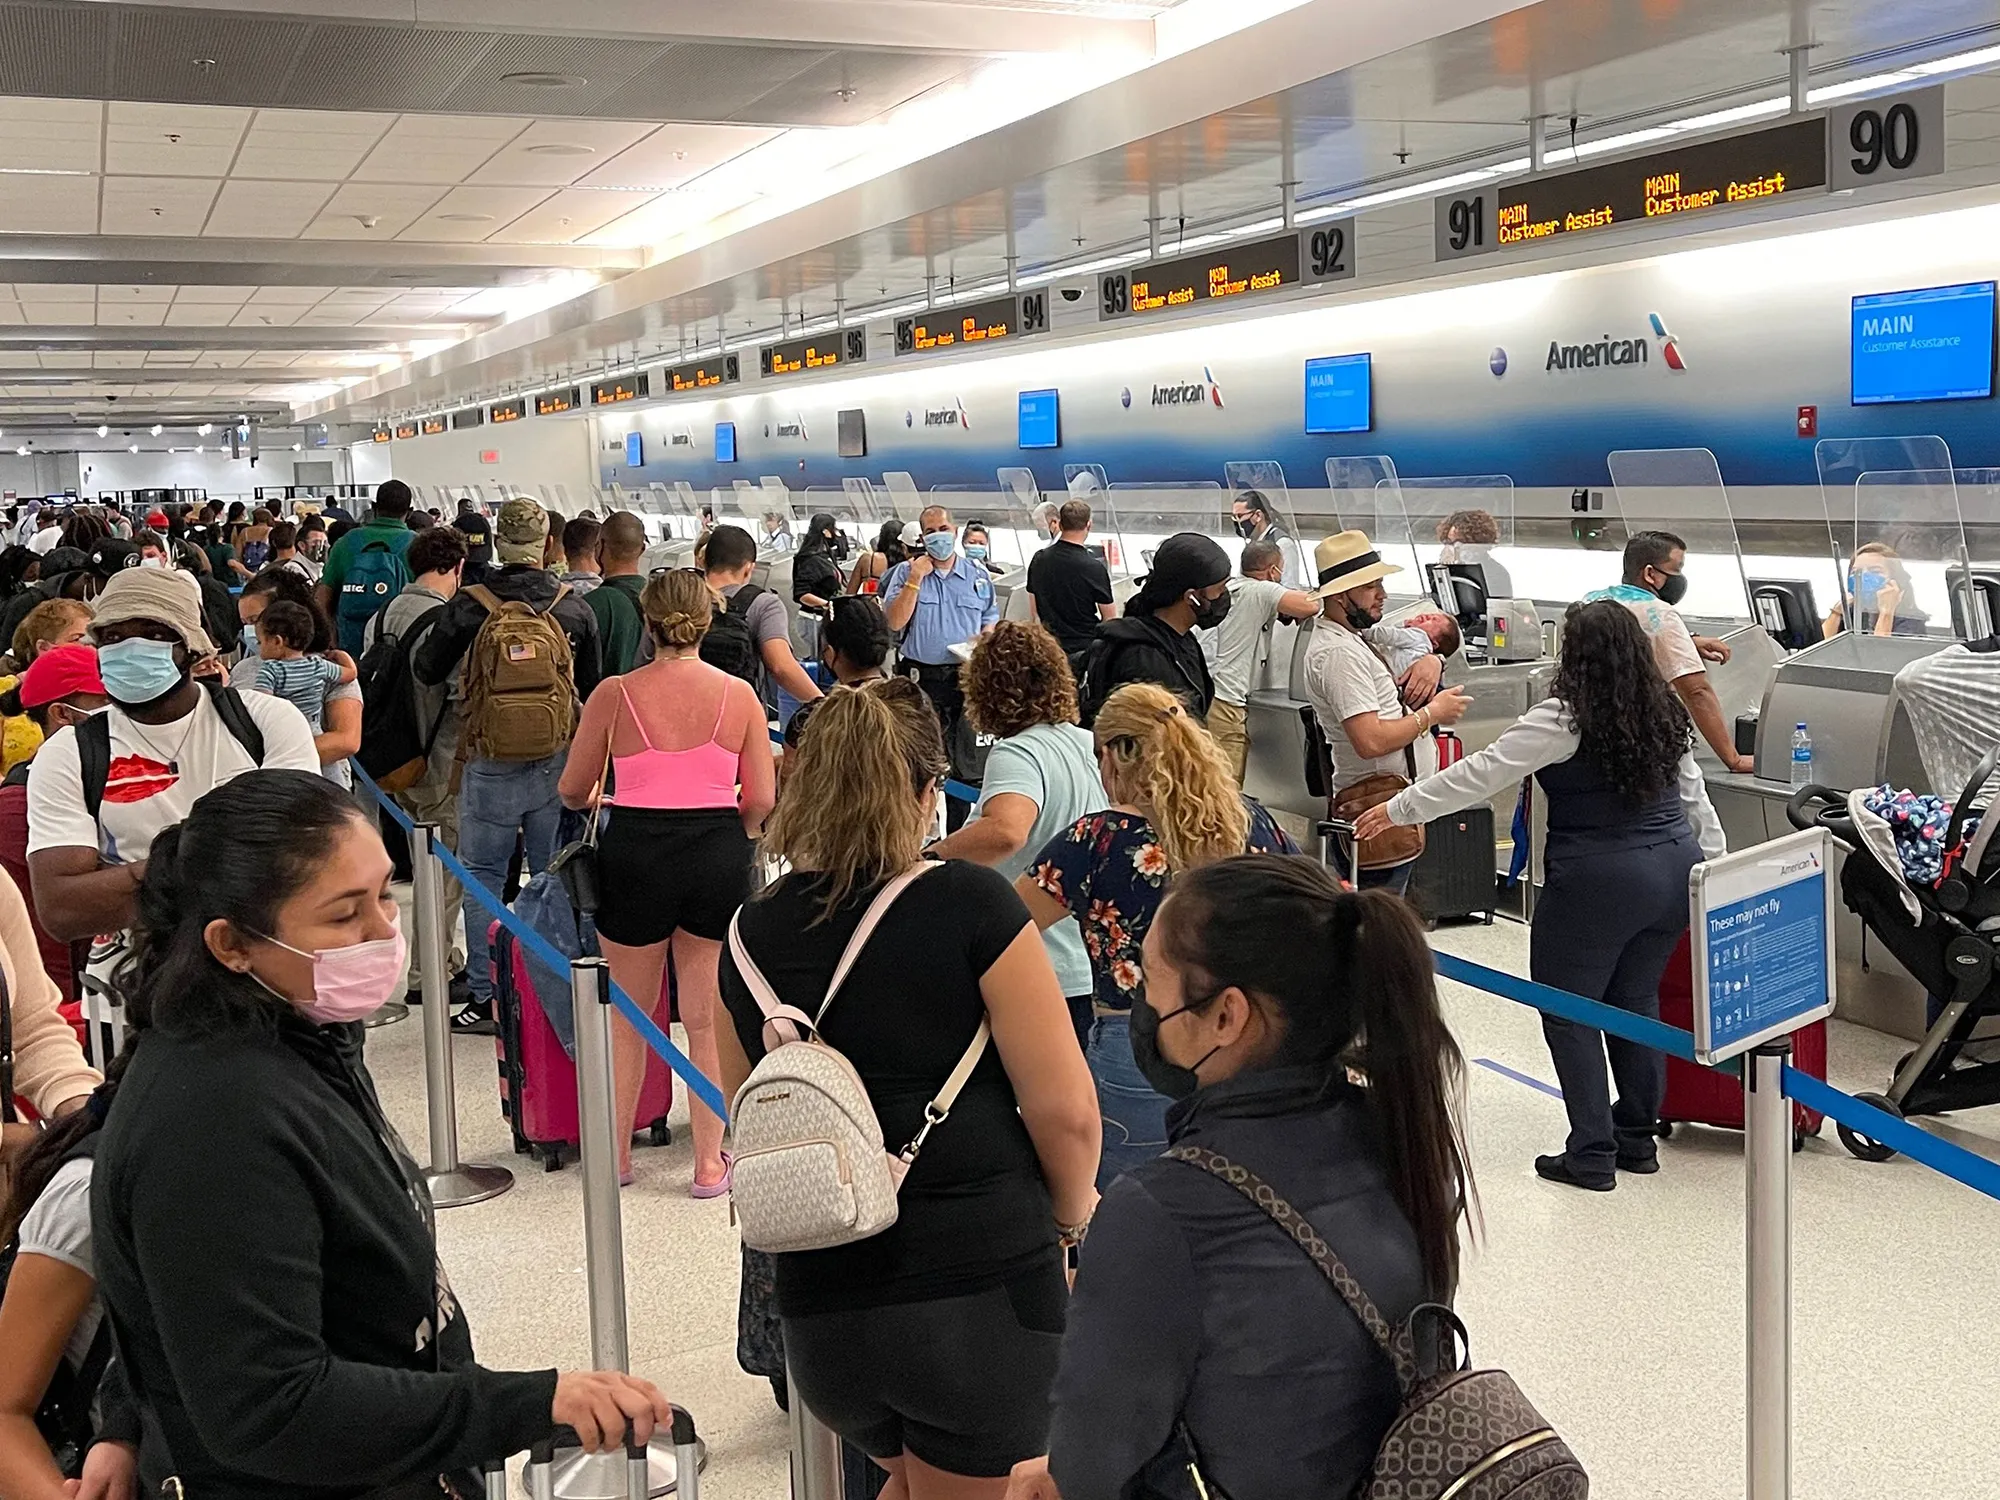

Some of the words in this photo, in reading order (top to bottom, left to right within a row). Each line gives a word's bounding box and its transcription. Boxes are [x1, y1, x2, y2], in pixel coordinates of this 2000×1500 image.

[1849, 103, 1919, 176] 90
[1645, 173, 1680, 197] MAIN
[1645, 188, 1720, 217] Customer
[1727, 172, 1786, 202] Assist
[1448, 198, 1483, 250] 91
[1499, 203, 1528, 226] MAIN
[1499, 217, 1561, 244] Customer
[1566, 205, 1614, 231] Assist
[1311, 228, 1344, 276] 92
[1103, 275, 1127, 313] 93
[1167, 286, 1195, 305] Assist
[1209, 279, 1249, 298] Customer
[1250, 269, 1281, 290] Assist
[1023, 294, 1044, 330] 94
[1862, 315, 1914, 337] MAIN
[847, 330, 863, 359] 96
[897, 319, 913, 350] 95
[1862, 341, 1908, 354] Customer
[1909, 335, 1961, 350] Assistance
[1545, 333, 1648, 371] American
[1151, 380, 1205, 406] American
[1310, 373, 1335, 388] MAIN
[924, 406, 958, 427] American
[1780, 860, 1811, 876] American
[1710, 916, 1734, 933] These
[1735, 909, 1754, 925] may
[1754, 904, 1769, 918] not
[1769, 898, 1781, 915] fly
